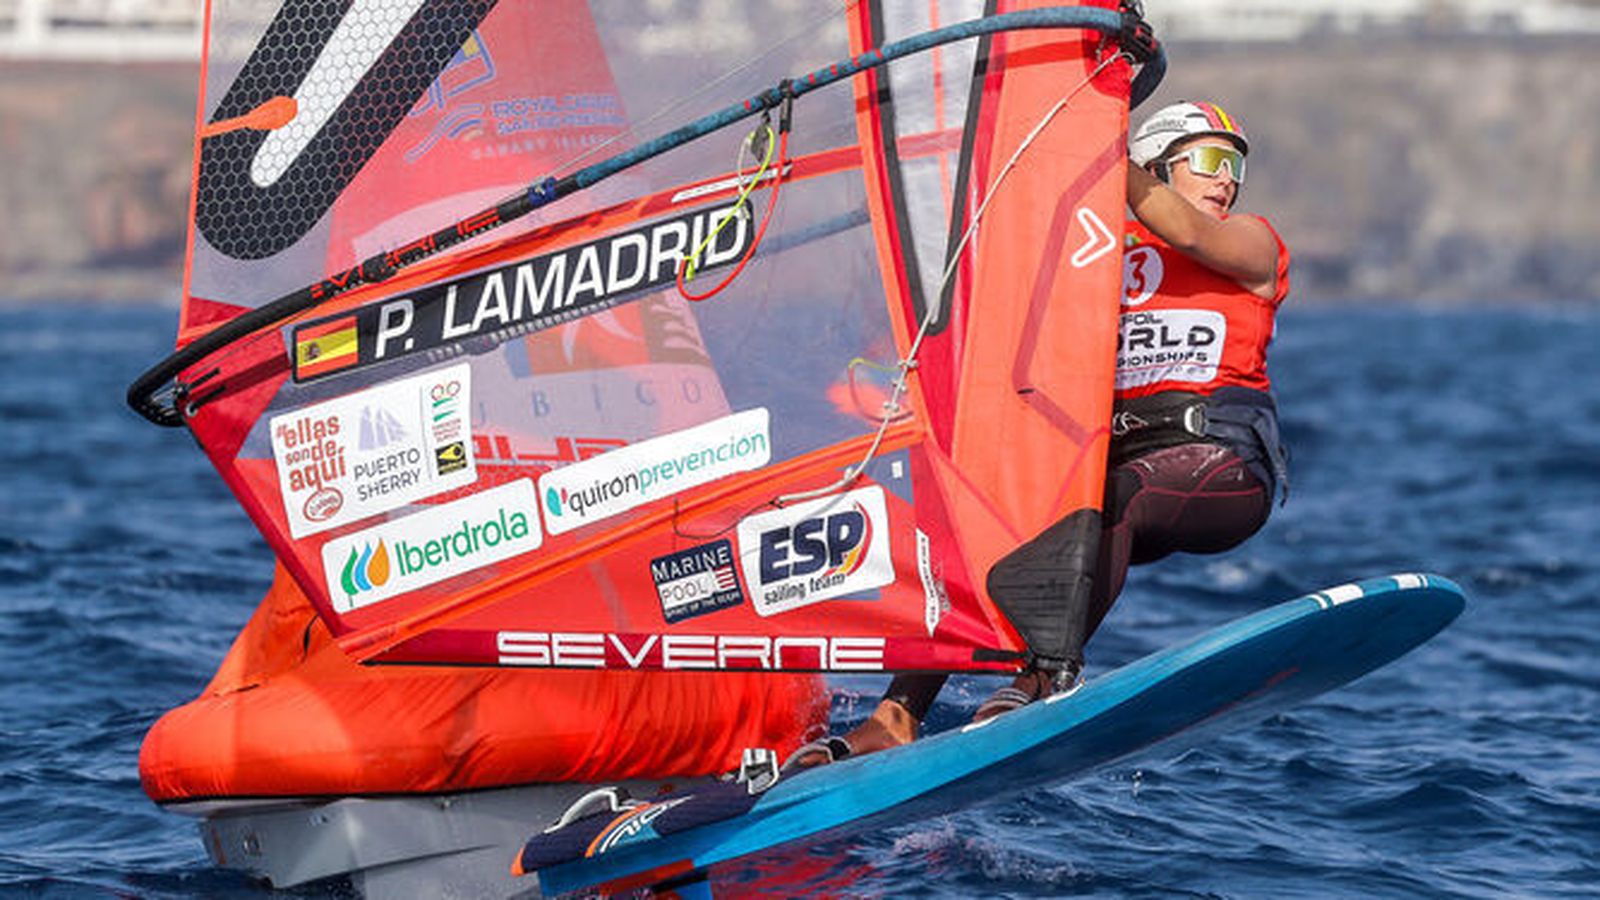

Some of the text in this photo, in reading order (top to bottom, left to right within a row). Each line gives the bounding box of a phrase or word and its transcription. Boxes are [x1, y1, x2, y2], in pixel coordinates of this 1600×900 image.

[375, 301, 414, 359] P.
[441, 206, 748, 339] LAMADRID
[354, 448, 420, 481] PUERTO
[357, 468, 421, 501] SHERRY
[395, 509, 529, 577] Iberdrola
[760, 511, 864, 586] ESP
[652, 546, 730, 583] MARINE
[809, 573, 845, 593] team
[497, 631, 885, 670] SEVERNE
